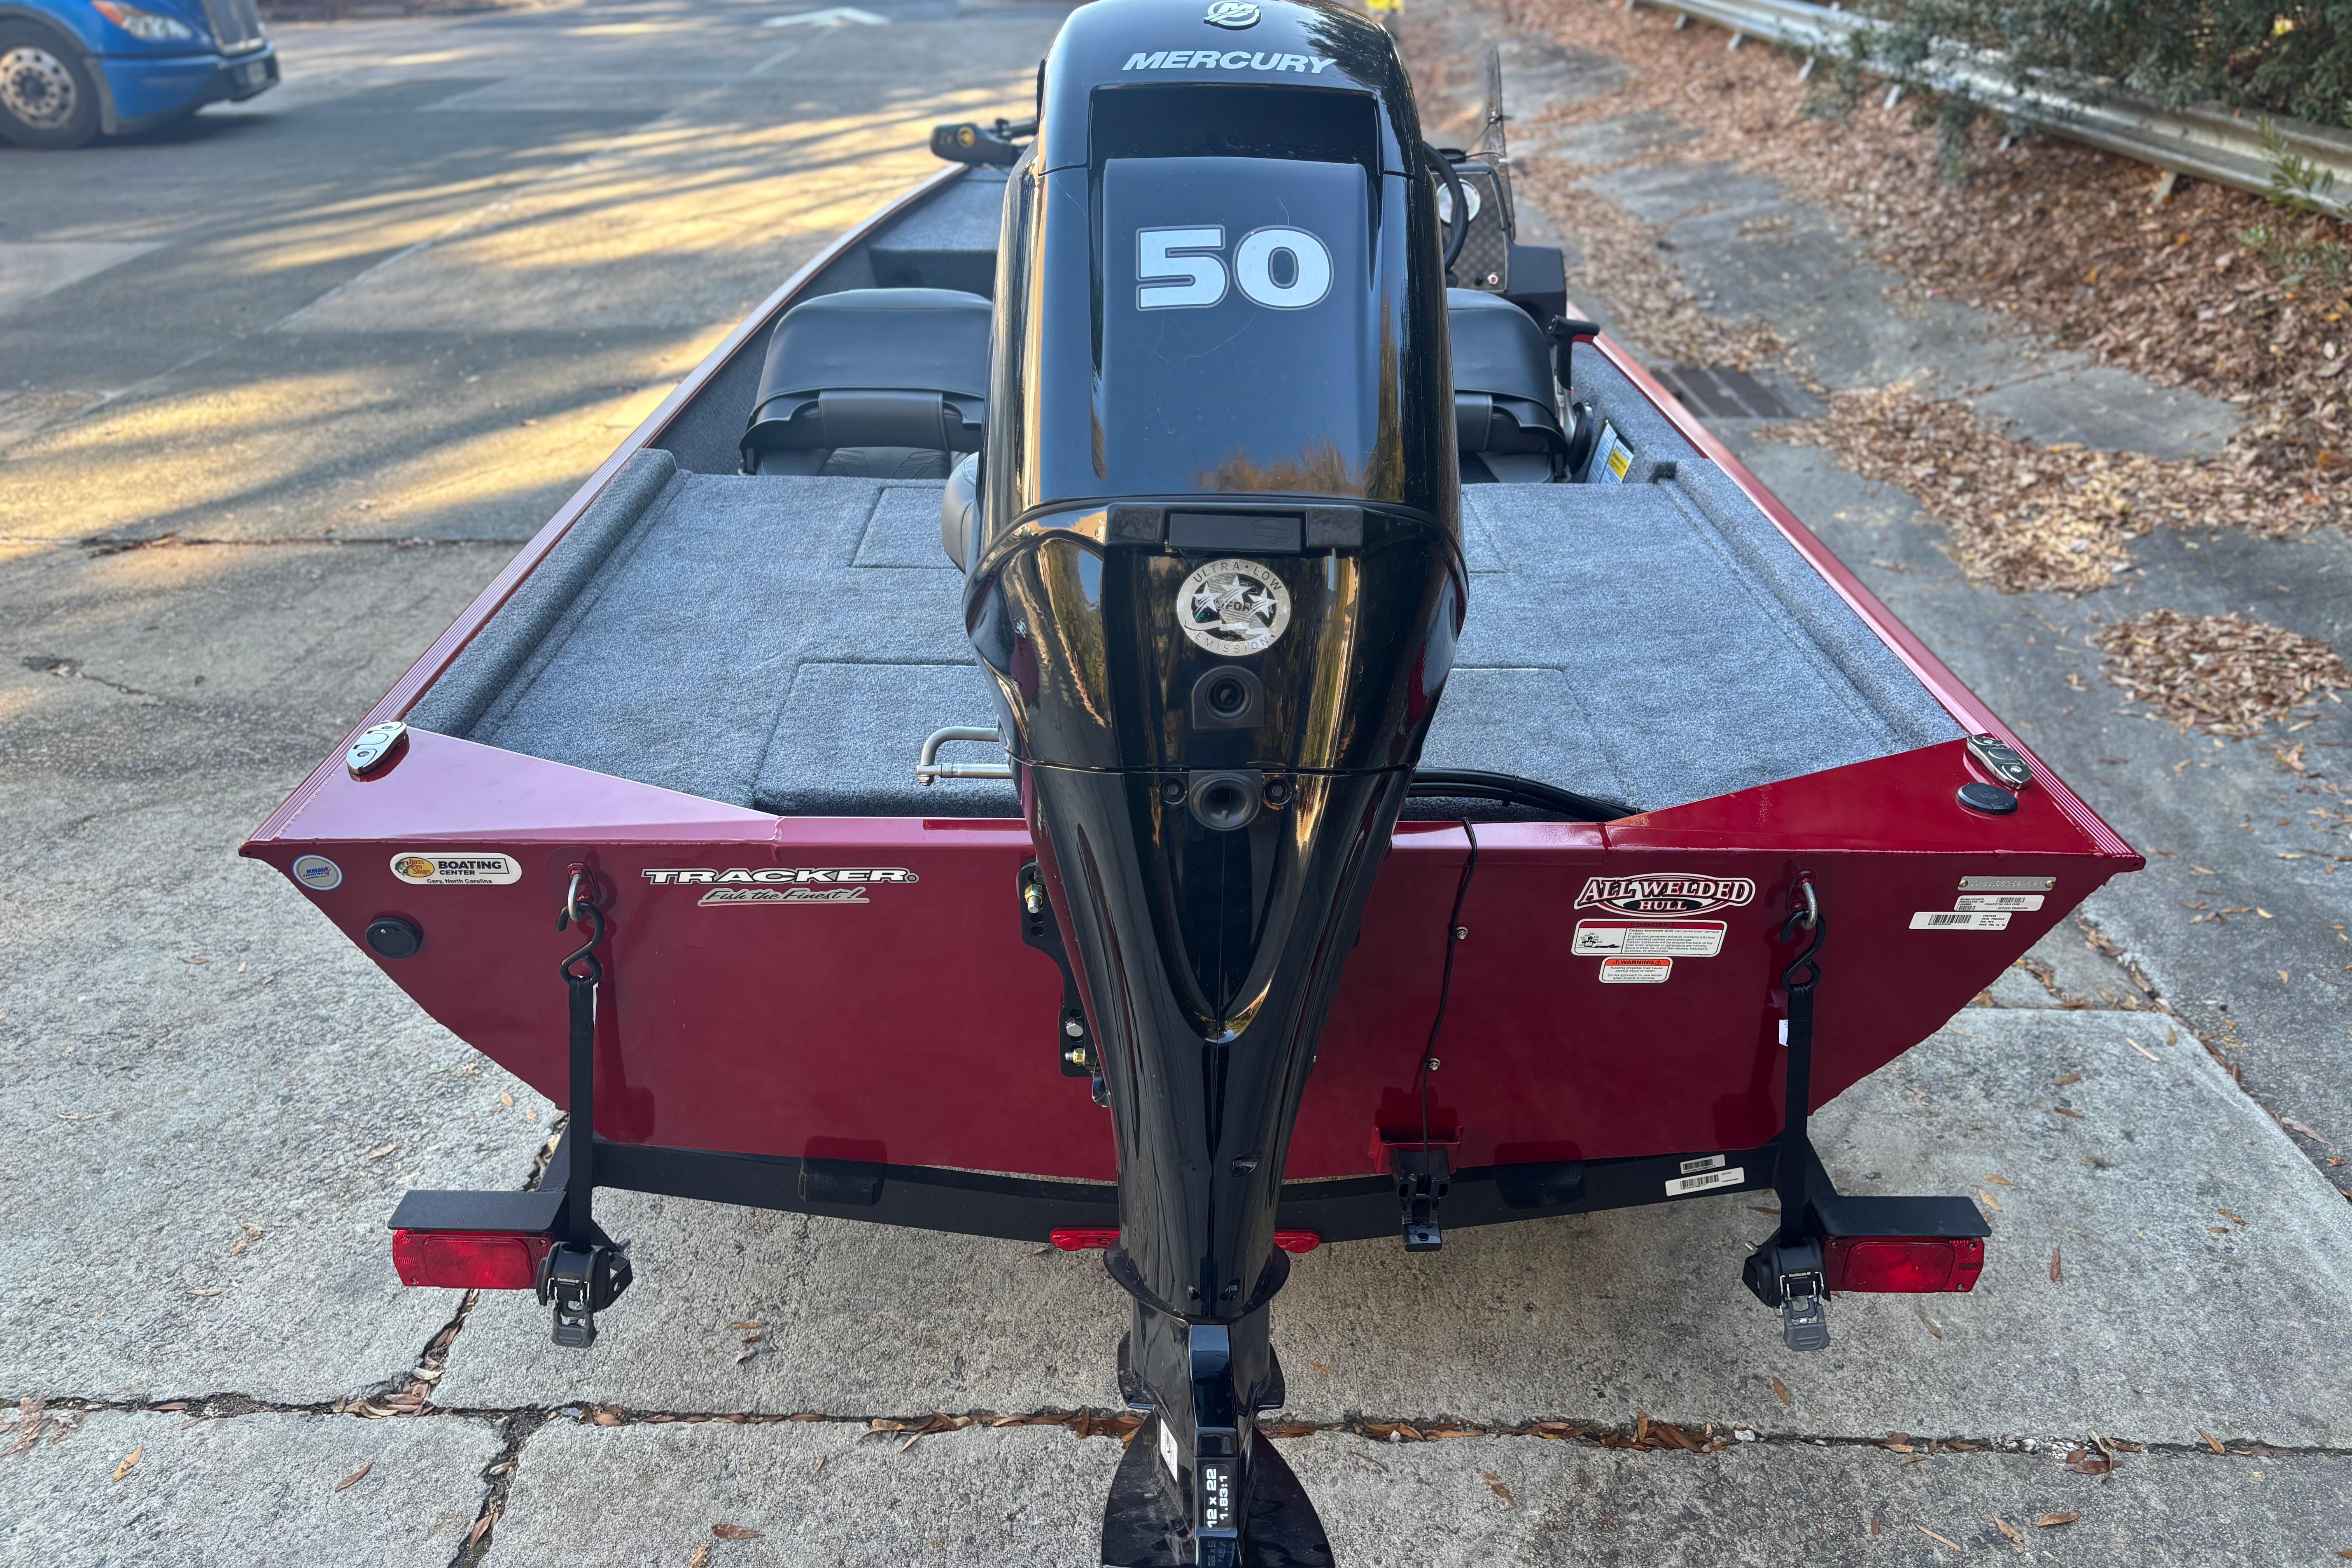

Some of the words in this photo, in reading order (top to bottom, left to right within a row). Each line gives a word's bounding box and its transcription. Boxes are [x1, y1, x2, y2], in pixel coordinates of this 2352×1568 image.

[1122, 50, 1337, 73] MERCURY
[1136, 226, 1333, 310] 50
[1193, 561, 1240, 583] ULTRA
[1253, 567, 1282, 590] LOW
[1195, 632, 1269, 653] EMISSION
[706, 889, 746, 901] Fish
[751, 889, 782, 900] the
[1579, 879, 1635, 905] ALL
[1639, 880, 1750, 902] WELDED
[1638, 901, 1687, 910] HULL
[1206, 1468, 1217, 1491] 22
[1209, 1496, 1217, 1505] x
[1219, 1476, 1228, 1520] 1.83:1
[1207, 1509, 1217, 1528] 12
